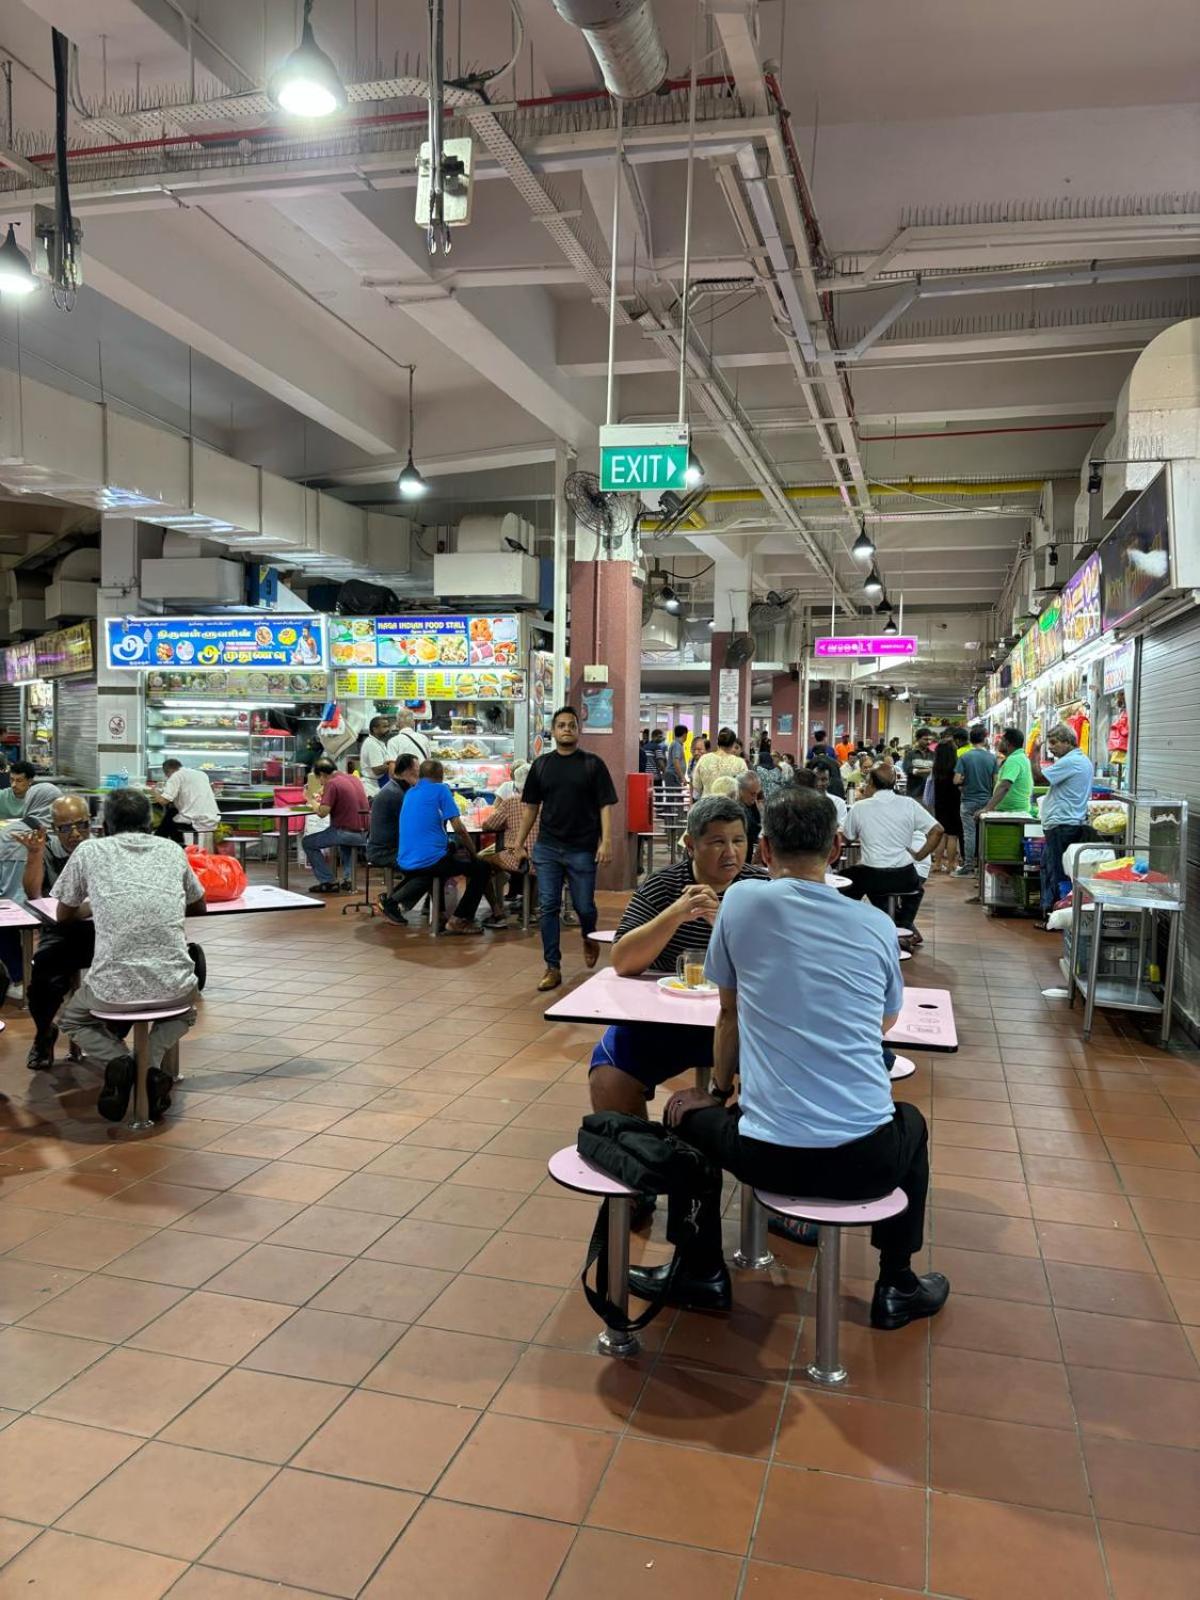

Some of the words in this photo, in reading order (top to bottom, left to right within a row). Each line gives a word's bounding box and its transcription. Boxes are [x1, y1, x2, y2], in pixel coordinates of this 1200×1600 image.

[611, 455, 662, 483] EXIT
[425, 621, 444, 629] FOOD
[445, 621, 466, 629] STALL
